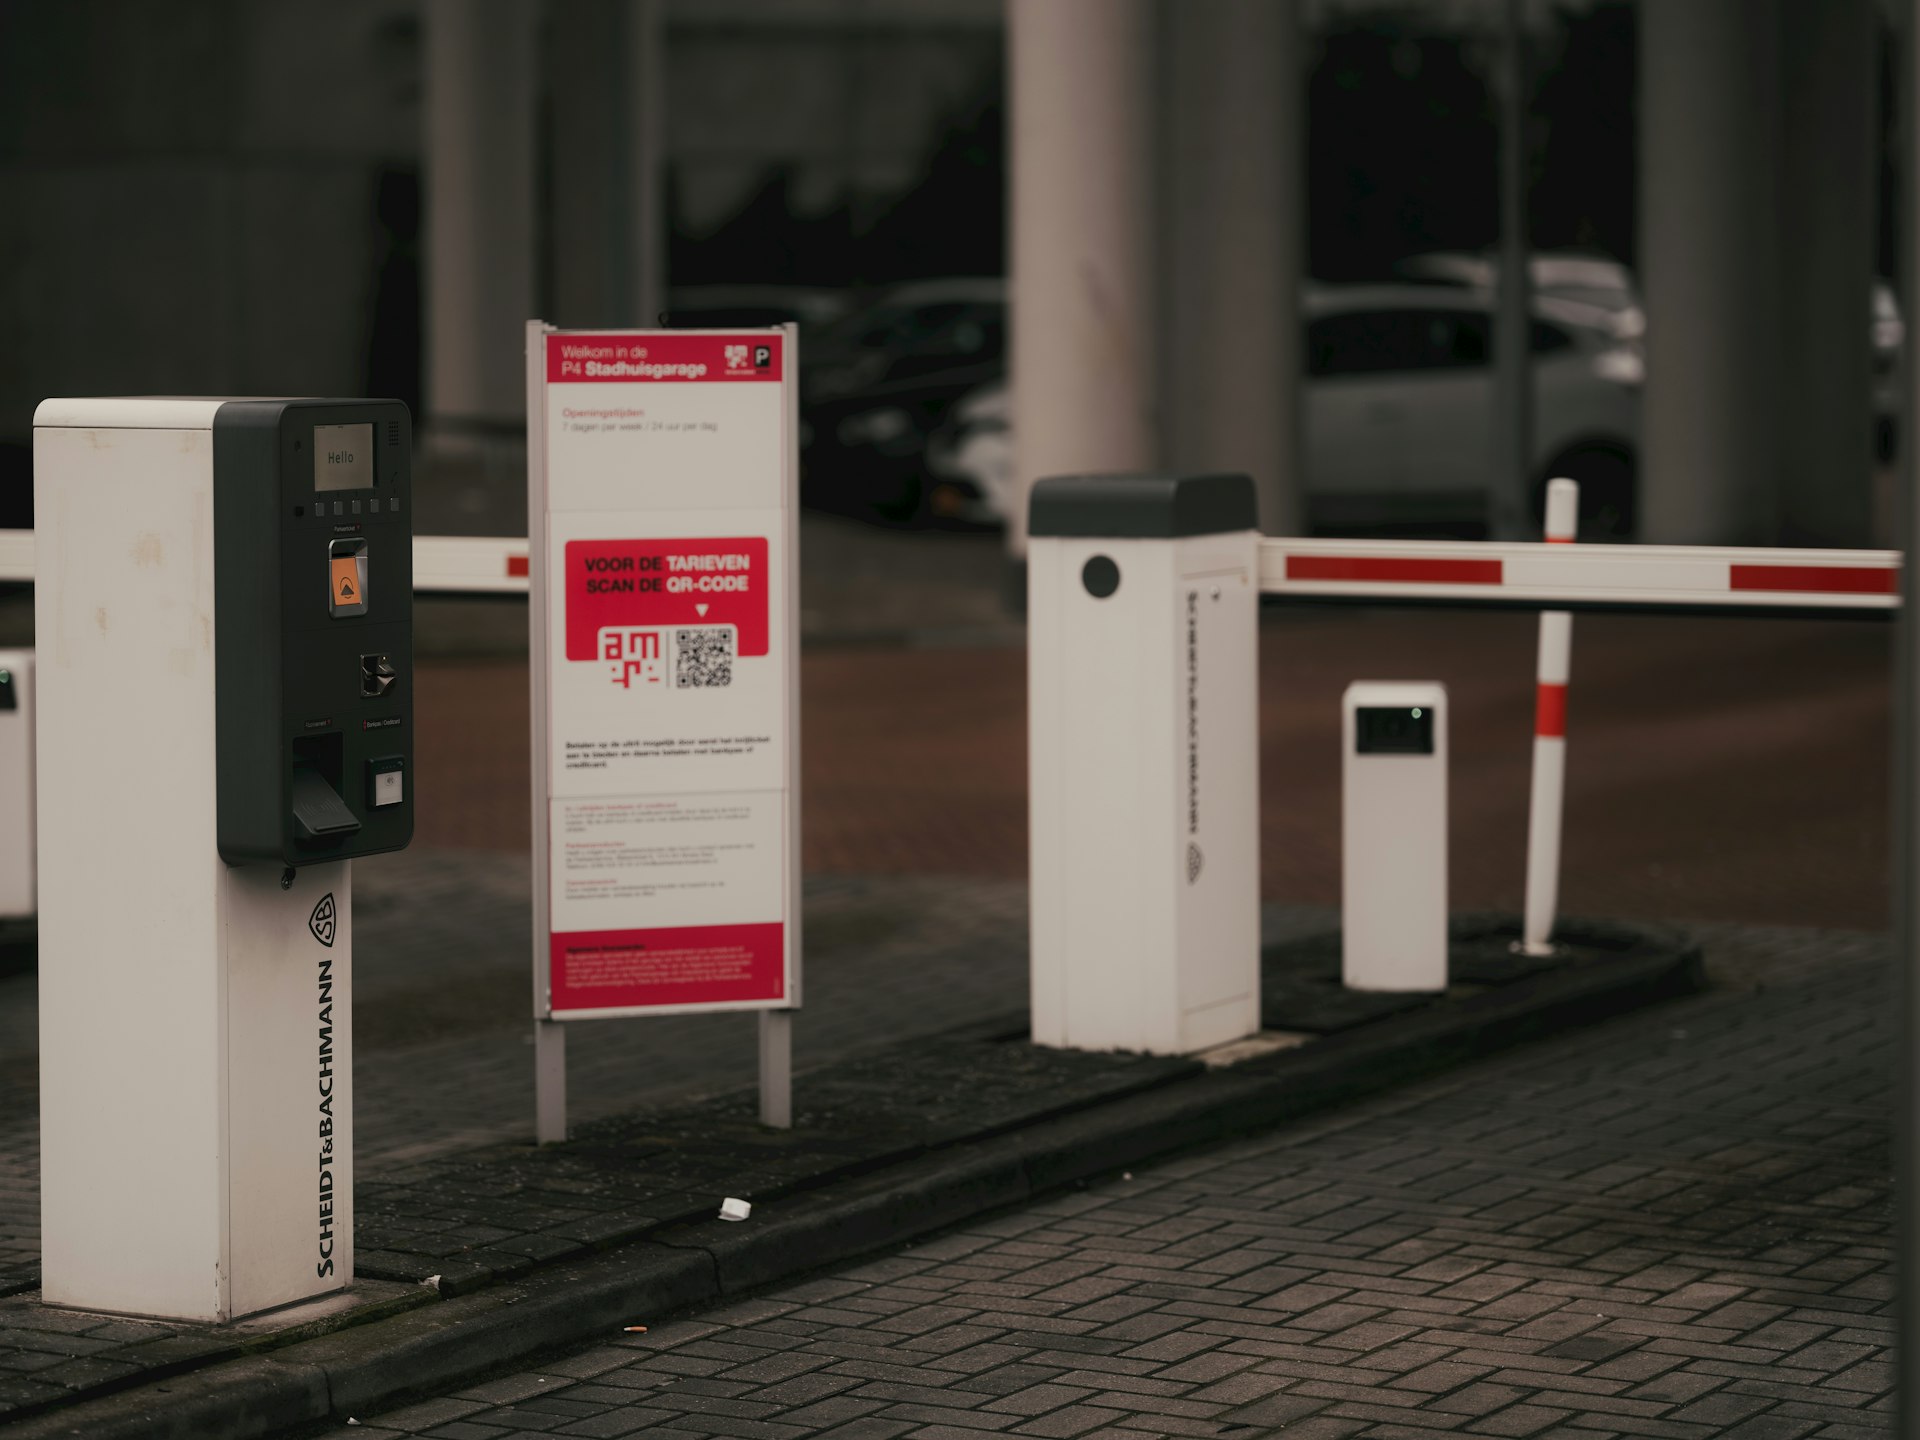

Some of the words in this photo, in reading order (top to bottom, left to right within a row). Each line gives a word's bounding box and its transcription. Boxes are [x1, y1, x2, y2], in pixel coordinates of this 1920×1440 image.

[561, 345, 614, 359] Welkom
[615, 345, 628, 359] in
[630, 345, 648, 359] de
[561, 361, 582, 376] P4
[585, 360, 708, 379] Stadhuisgarage
[562, 407, 645, 421] Openingstijden
[570, 422, 598, 433] dagen
[601, 423, 617, 433] per
[619, 421, 642, 431] week
[651, 421, 664, 431] 24
[666, 422, 681, 431] uur
[683, 422, 698, 432] per
[701, 421, 718, 432] dag
[328, 450, 354, 464] Hello
[585, 556, 635, 572] VOOR
[639, 556, 662, 571] DE
[666, 554, 750, 571] TARIEVEN
[586, 578, 634, 594] SCAN
[639, 577, 662, 592] DE
[666, 575, 749, 592] QR-CODE
[317, 959, 334, 1279] SCHEIDT&BACHMANN
